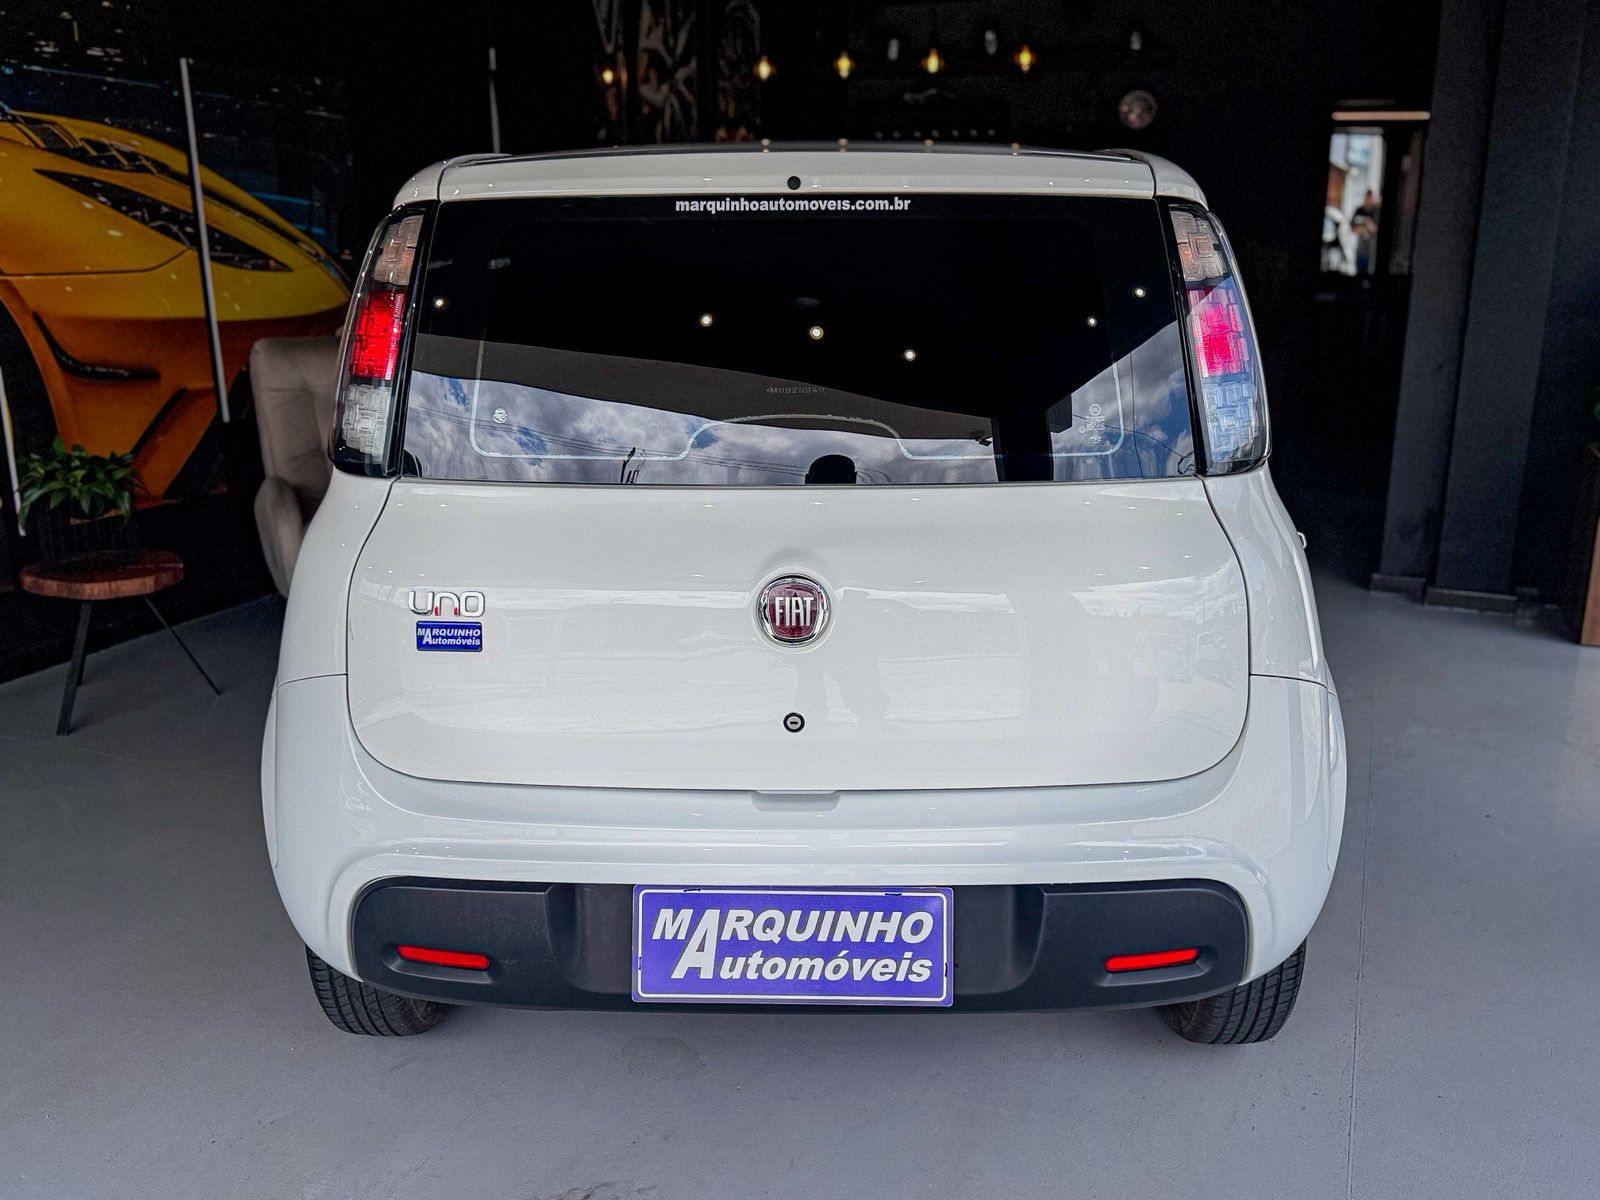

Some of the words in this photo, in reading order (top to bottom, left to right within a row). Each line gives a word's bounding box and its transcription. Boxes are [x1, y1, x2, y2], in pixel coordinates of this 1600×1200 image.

[675, 197, 911, 214] marquinhoautomoveis.com.br
[775, 596, 815, 627] FIAT
[417, 628, 481, 638] MARQUINHO
[422, 634, 481, 646] Automóveis
[652, 909, 934, 948] MARQUINHO
[671, 940, 933, 983] Automóveis
